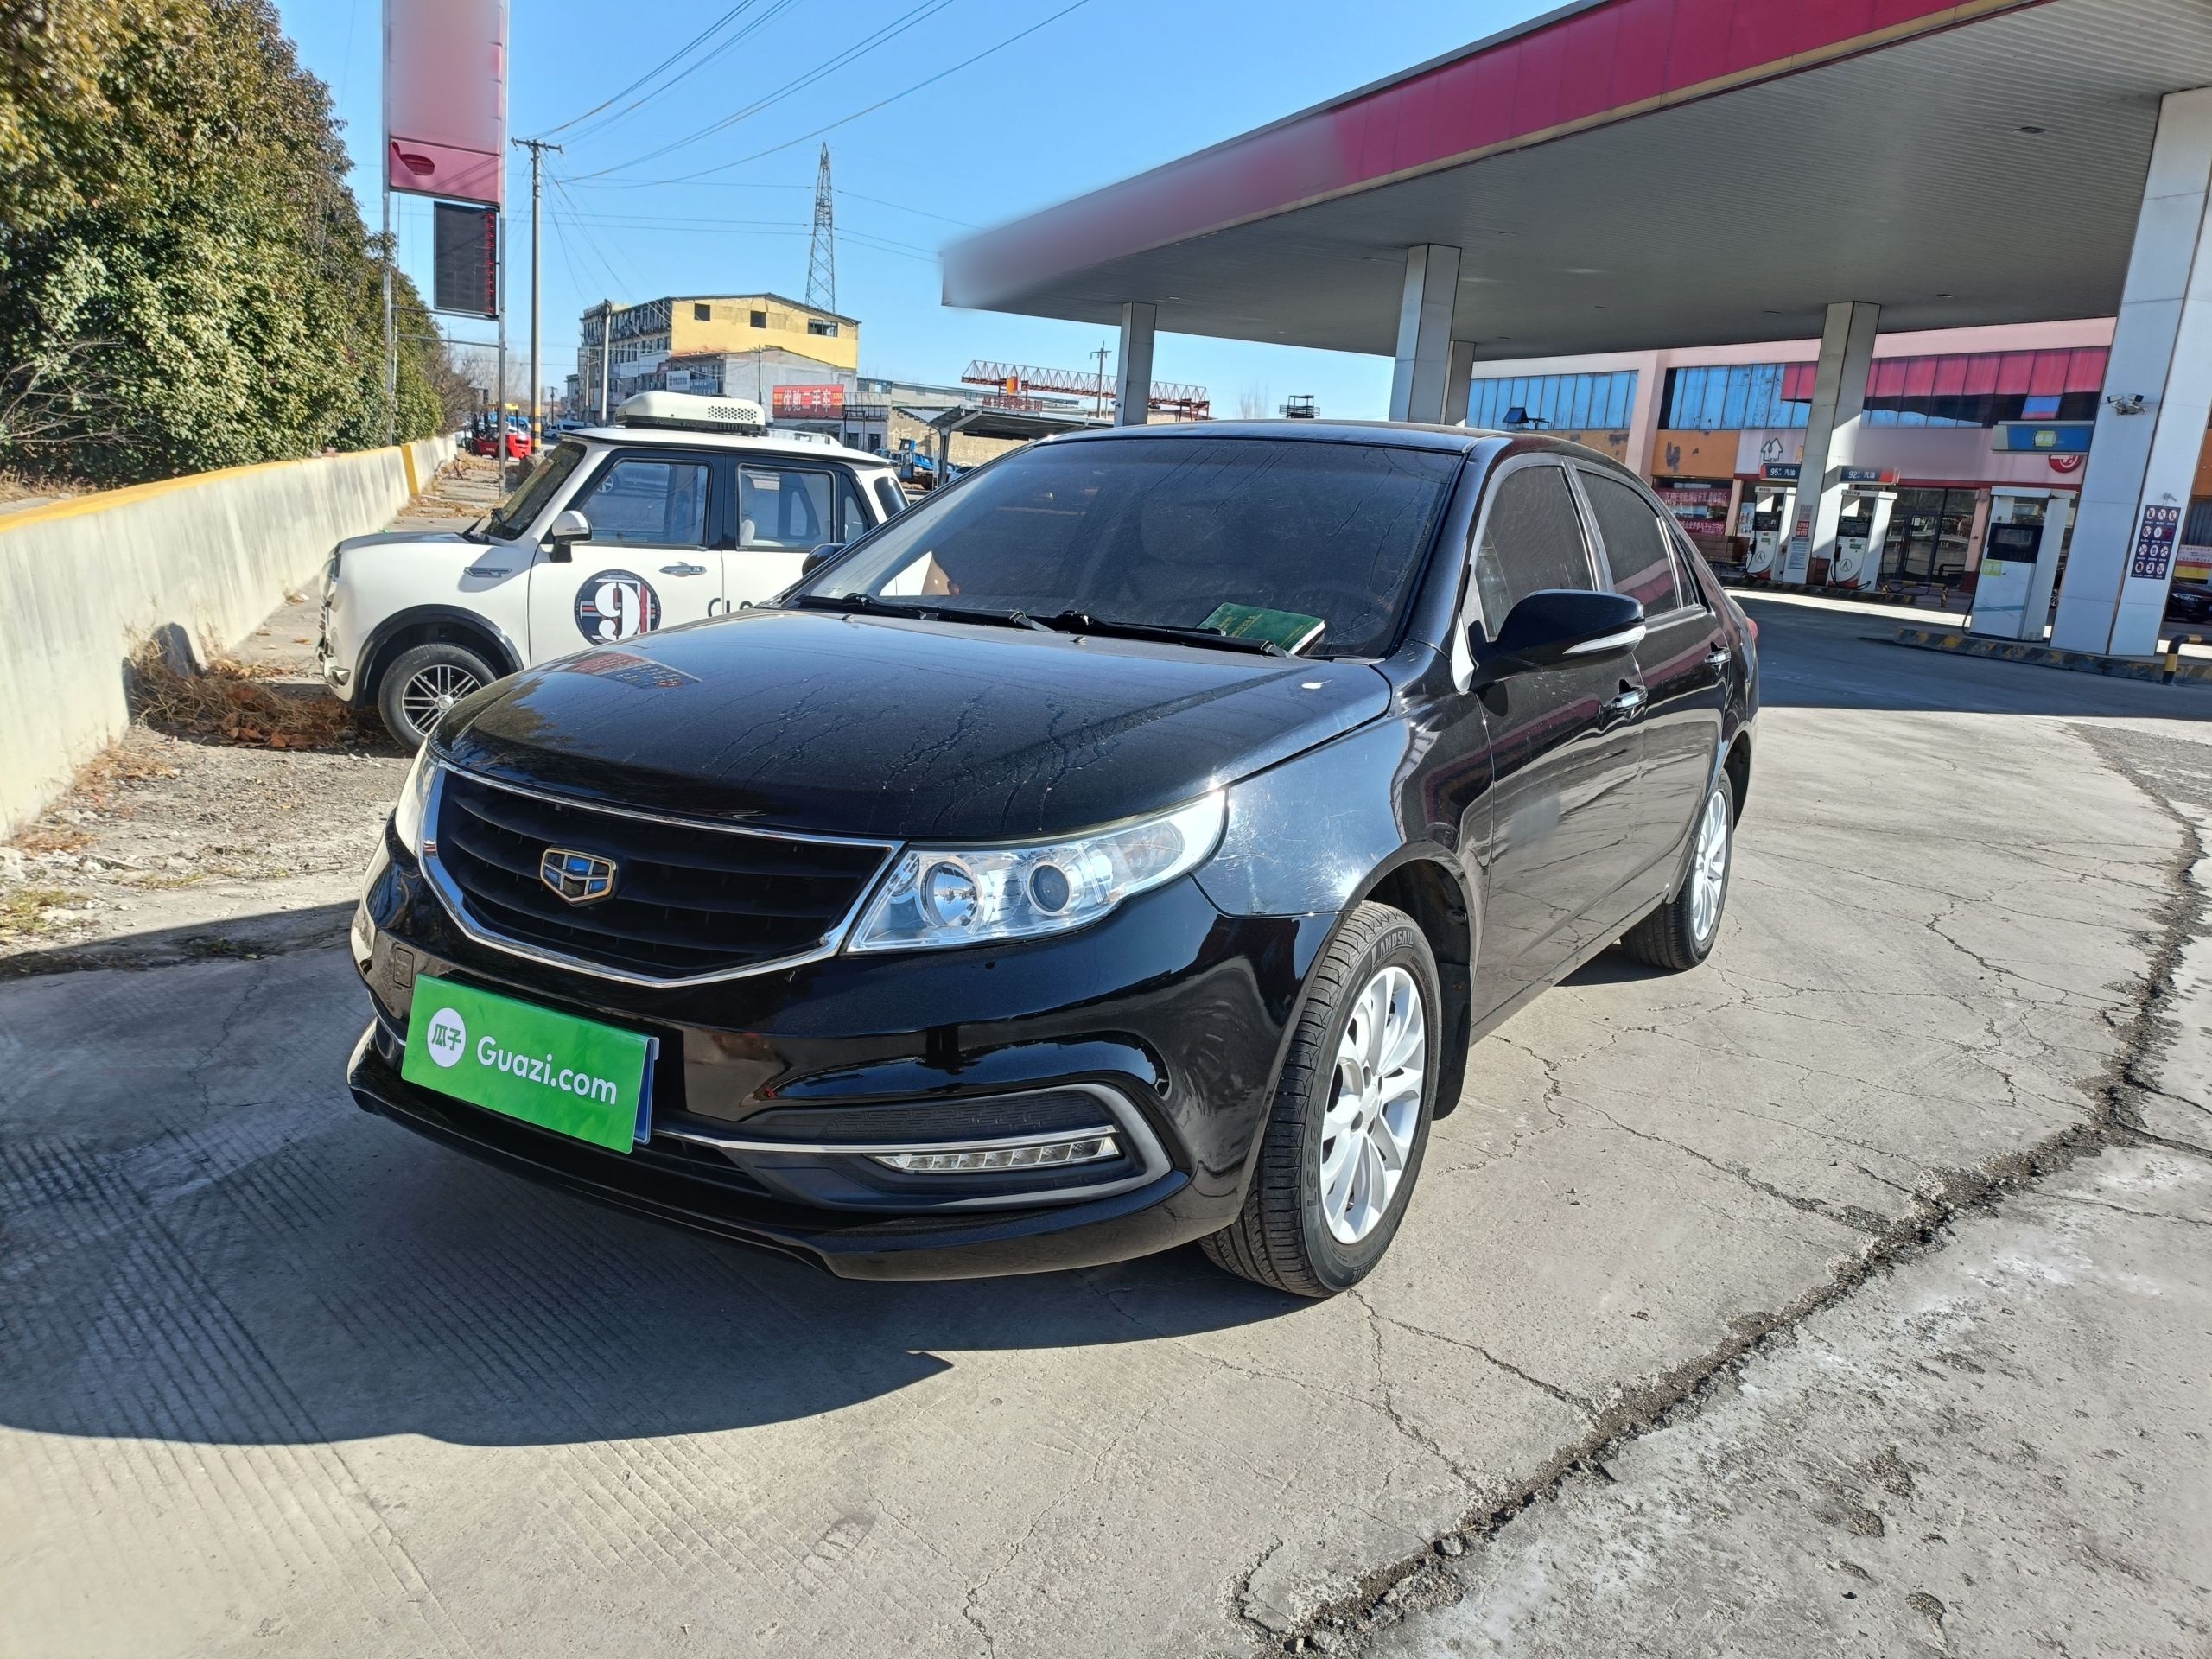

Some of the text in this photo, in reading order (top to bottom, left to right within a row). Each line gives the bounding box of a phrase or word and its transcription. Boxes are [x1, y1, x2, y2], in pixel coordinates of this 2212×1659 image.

[594, 582, 641, 641] 9
[1371, 931, 1414, 969] LANDSAIL
[431, 1023, 462, 1051] 瓜子
[476, 1035, 618, 1106] Guazi.com
